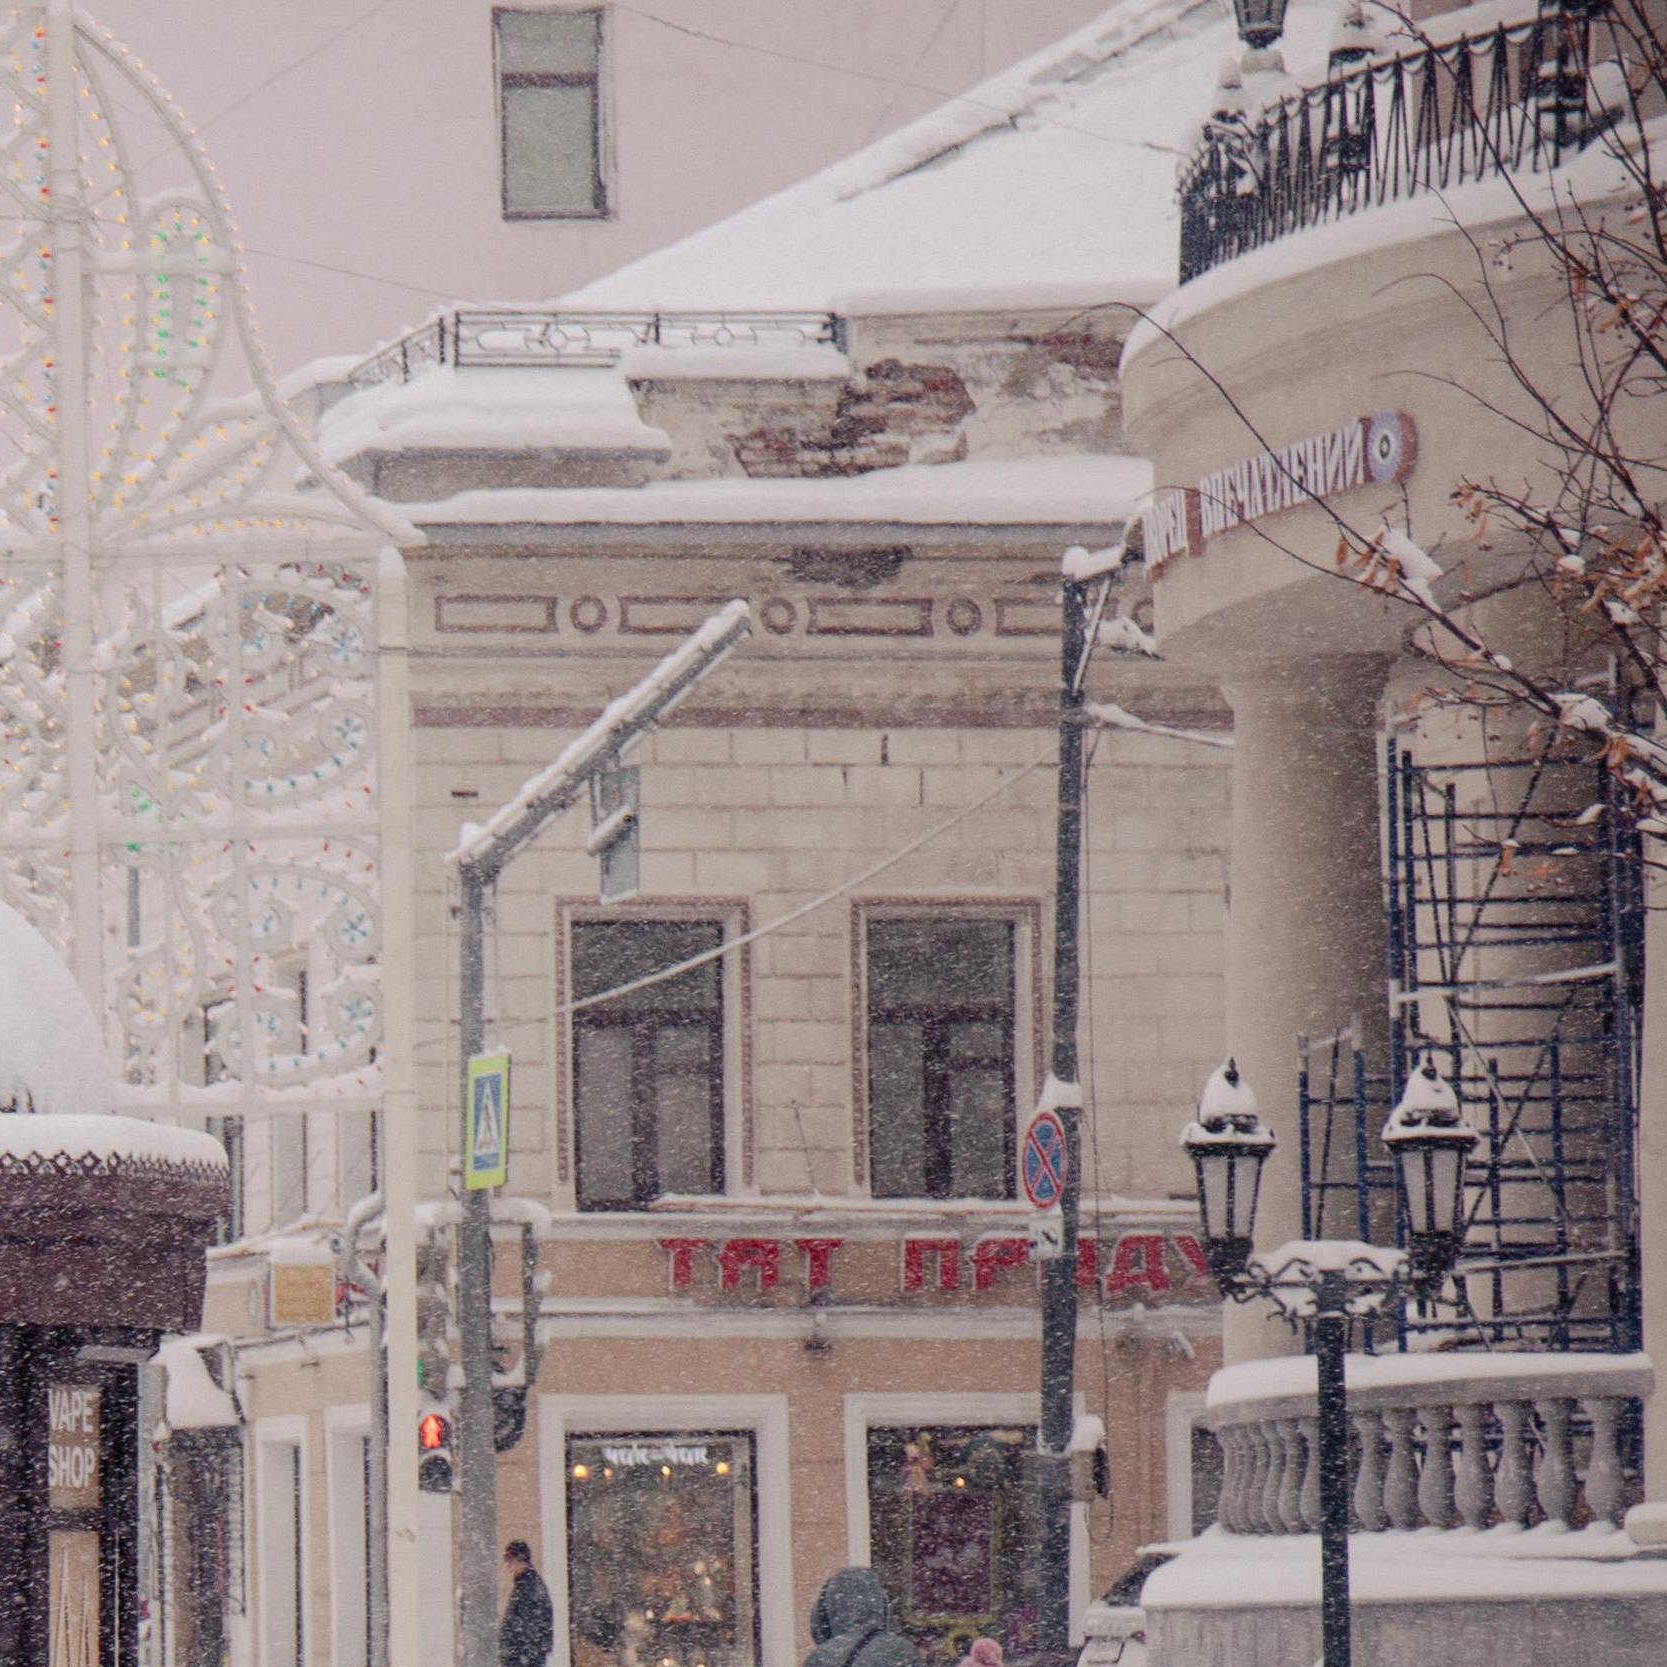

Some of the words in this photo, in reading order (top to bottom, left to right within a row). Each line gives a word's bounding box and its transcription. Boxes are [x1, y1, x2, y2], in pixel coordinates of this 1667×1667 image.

[657, 1236, 844, 1292] ТАТ
[48, 1388, 100, 1432] VAPE
[48, 1444, 96, 1488] SHOP
